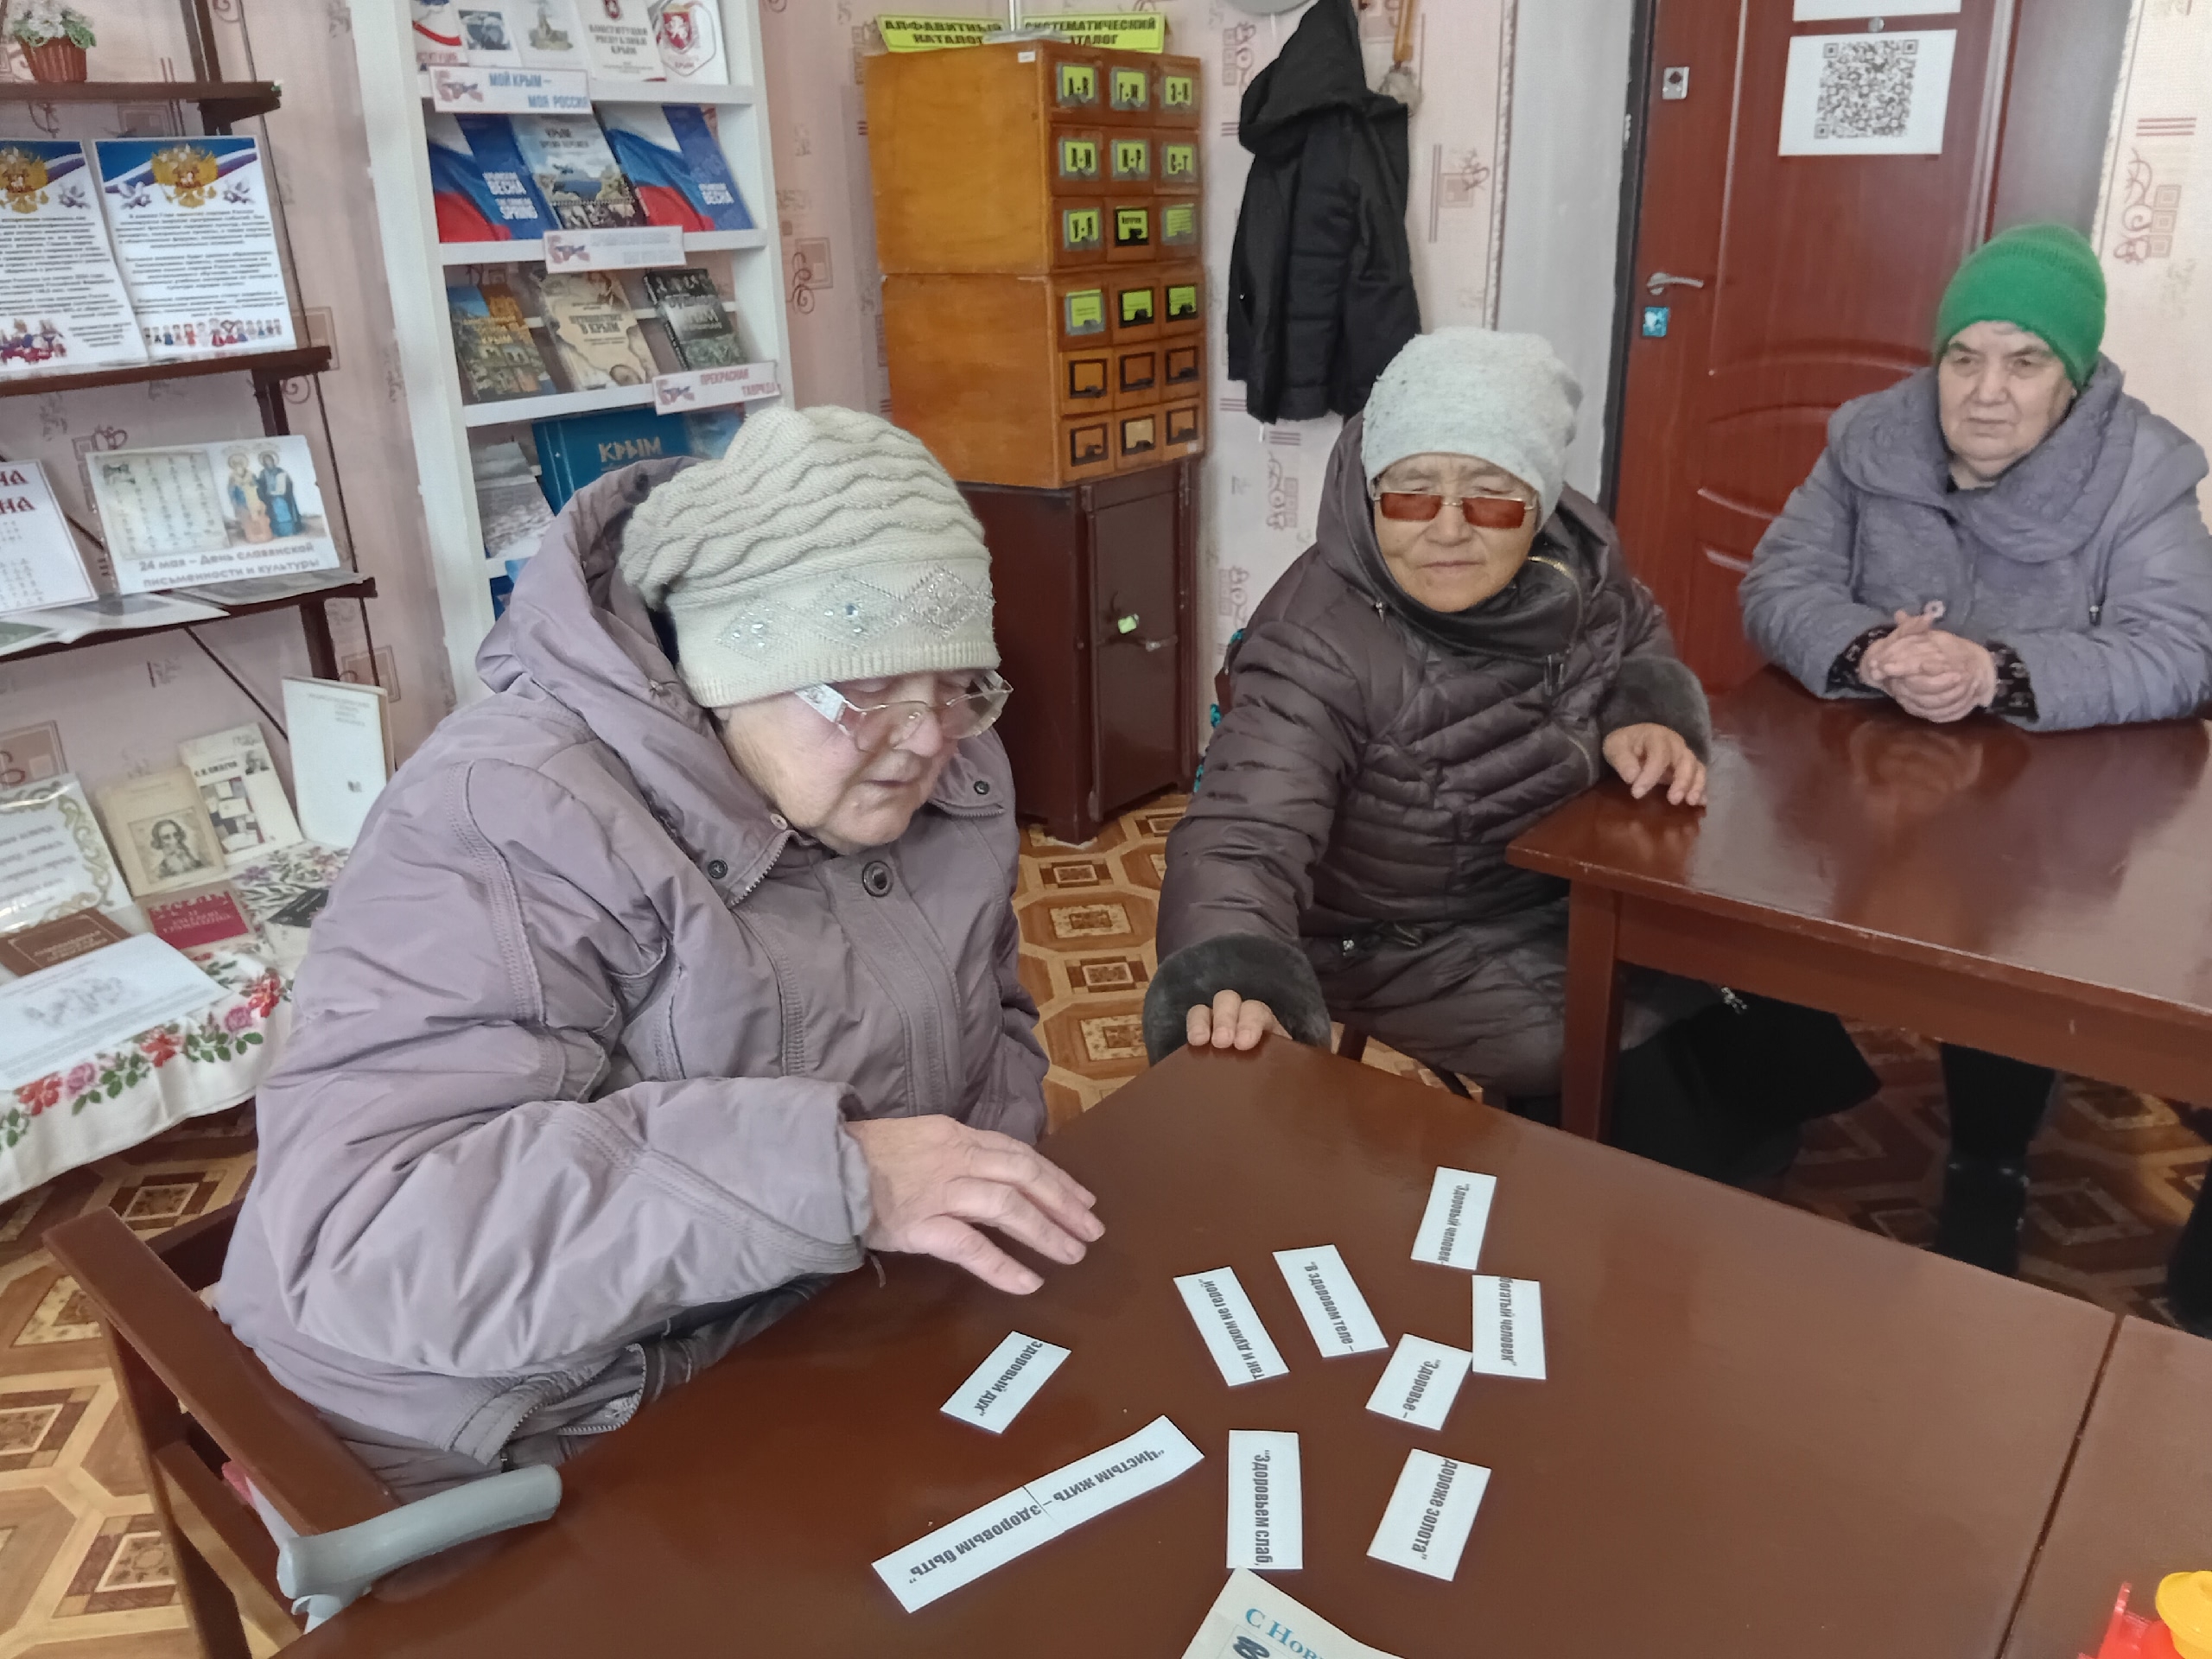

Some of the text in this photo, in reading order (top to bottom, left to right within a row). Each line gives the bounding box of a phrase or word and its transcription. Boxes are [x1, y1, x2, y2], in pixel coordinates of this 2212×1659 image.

[513, 74, 542, 87] КРЫМ
[487, 180, 527, 195] ВЕСНА
[598, 435, 662, 463] КРЫМ
[139, 559, 156, 571] 24
[158, 557, 187, 570] мая
[200, 554, 234, 565] День
[236, 542, 315, 562] славянской
[143, 558, 320, 588] письменности и культуры
[1308, 1273, 1342, 1320] здоровом
[1332, 1319, 1355, 1344] теле
[1499, 1277, 1514, 1318] богатый
[1217, 1306, 1234, 1320] не
[1224, 1319, 1253, 1351] духом
[991, 1340, 1044, 1393] здоровый
[1241, 1351, 1251, 1361] и
[1246, 1361, 1265, 1380] так
[1052, 1477, 1096, 1502] жить
[1428, 1459, 1459, 1508] дороже
[955, 1504, 1042, 1555] здоровым
[1254, 1529, 1274, 1567] слаб,
[1244, 1607, 1267, 1630] С
